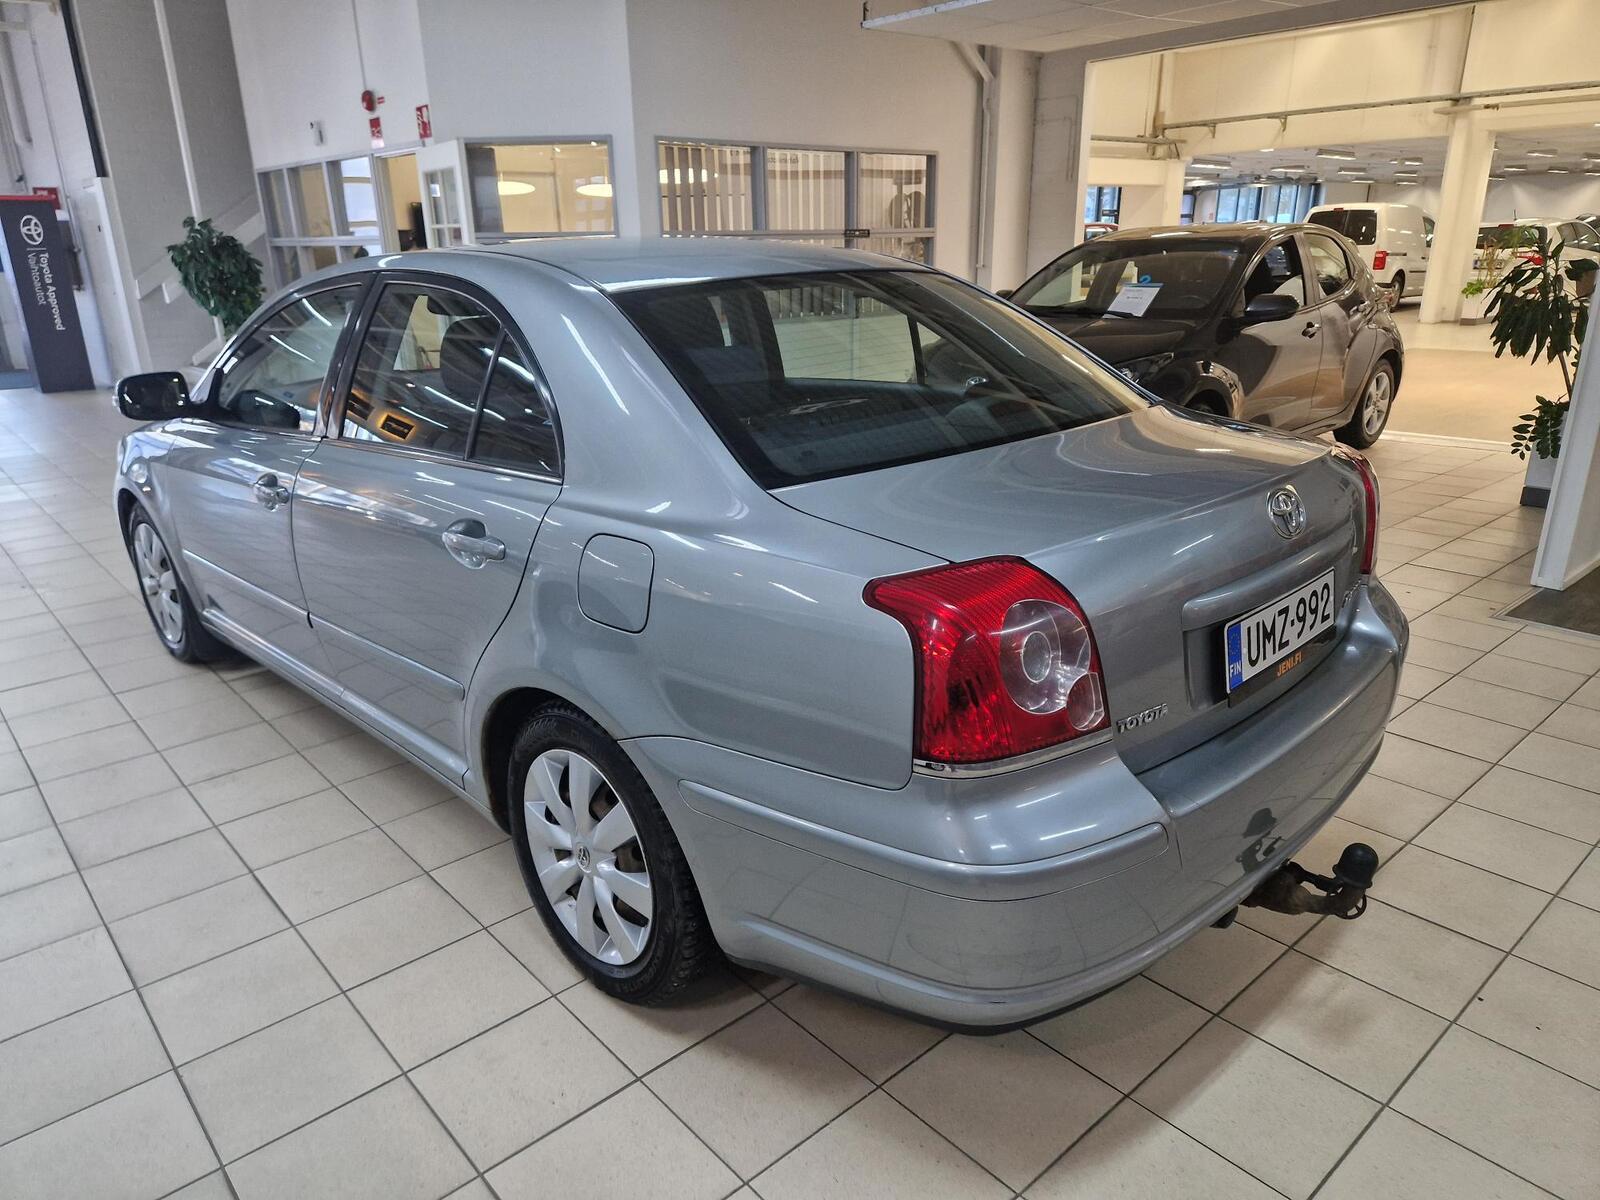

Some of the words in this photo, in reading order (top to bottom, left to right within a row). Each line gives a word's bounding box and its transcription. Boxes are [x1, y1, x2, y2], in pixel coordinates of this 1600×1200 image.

[27, 252, 46, 305] Vaihtoautot
[40, 252, 53, 284] Toyota
[47, 285, 66, 331] Approved
[1246, 582, 1331, 668] UMZ-992
[1229, 660, 1241, 678] FIN
[1276, 651, 1302, 677] JENI.FI
